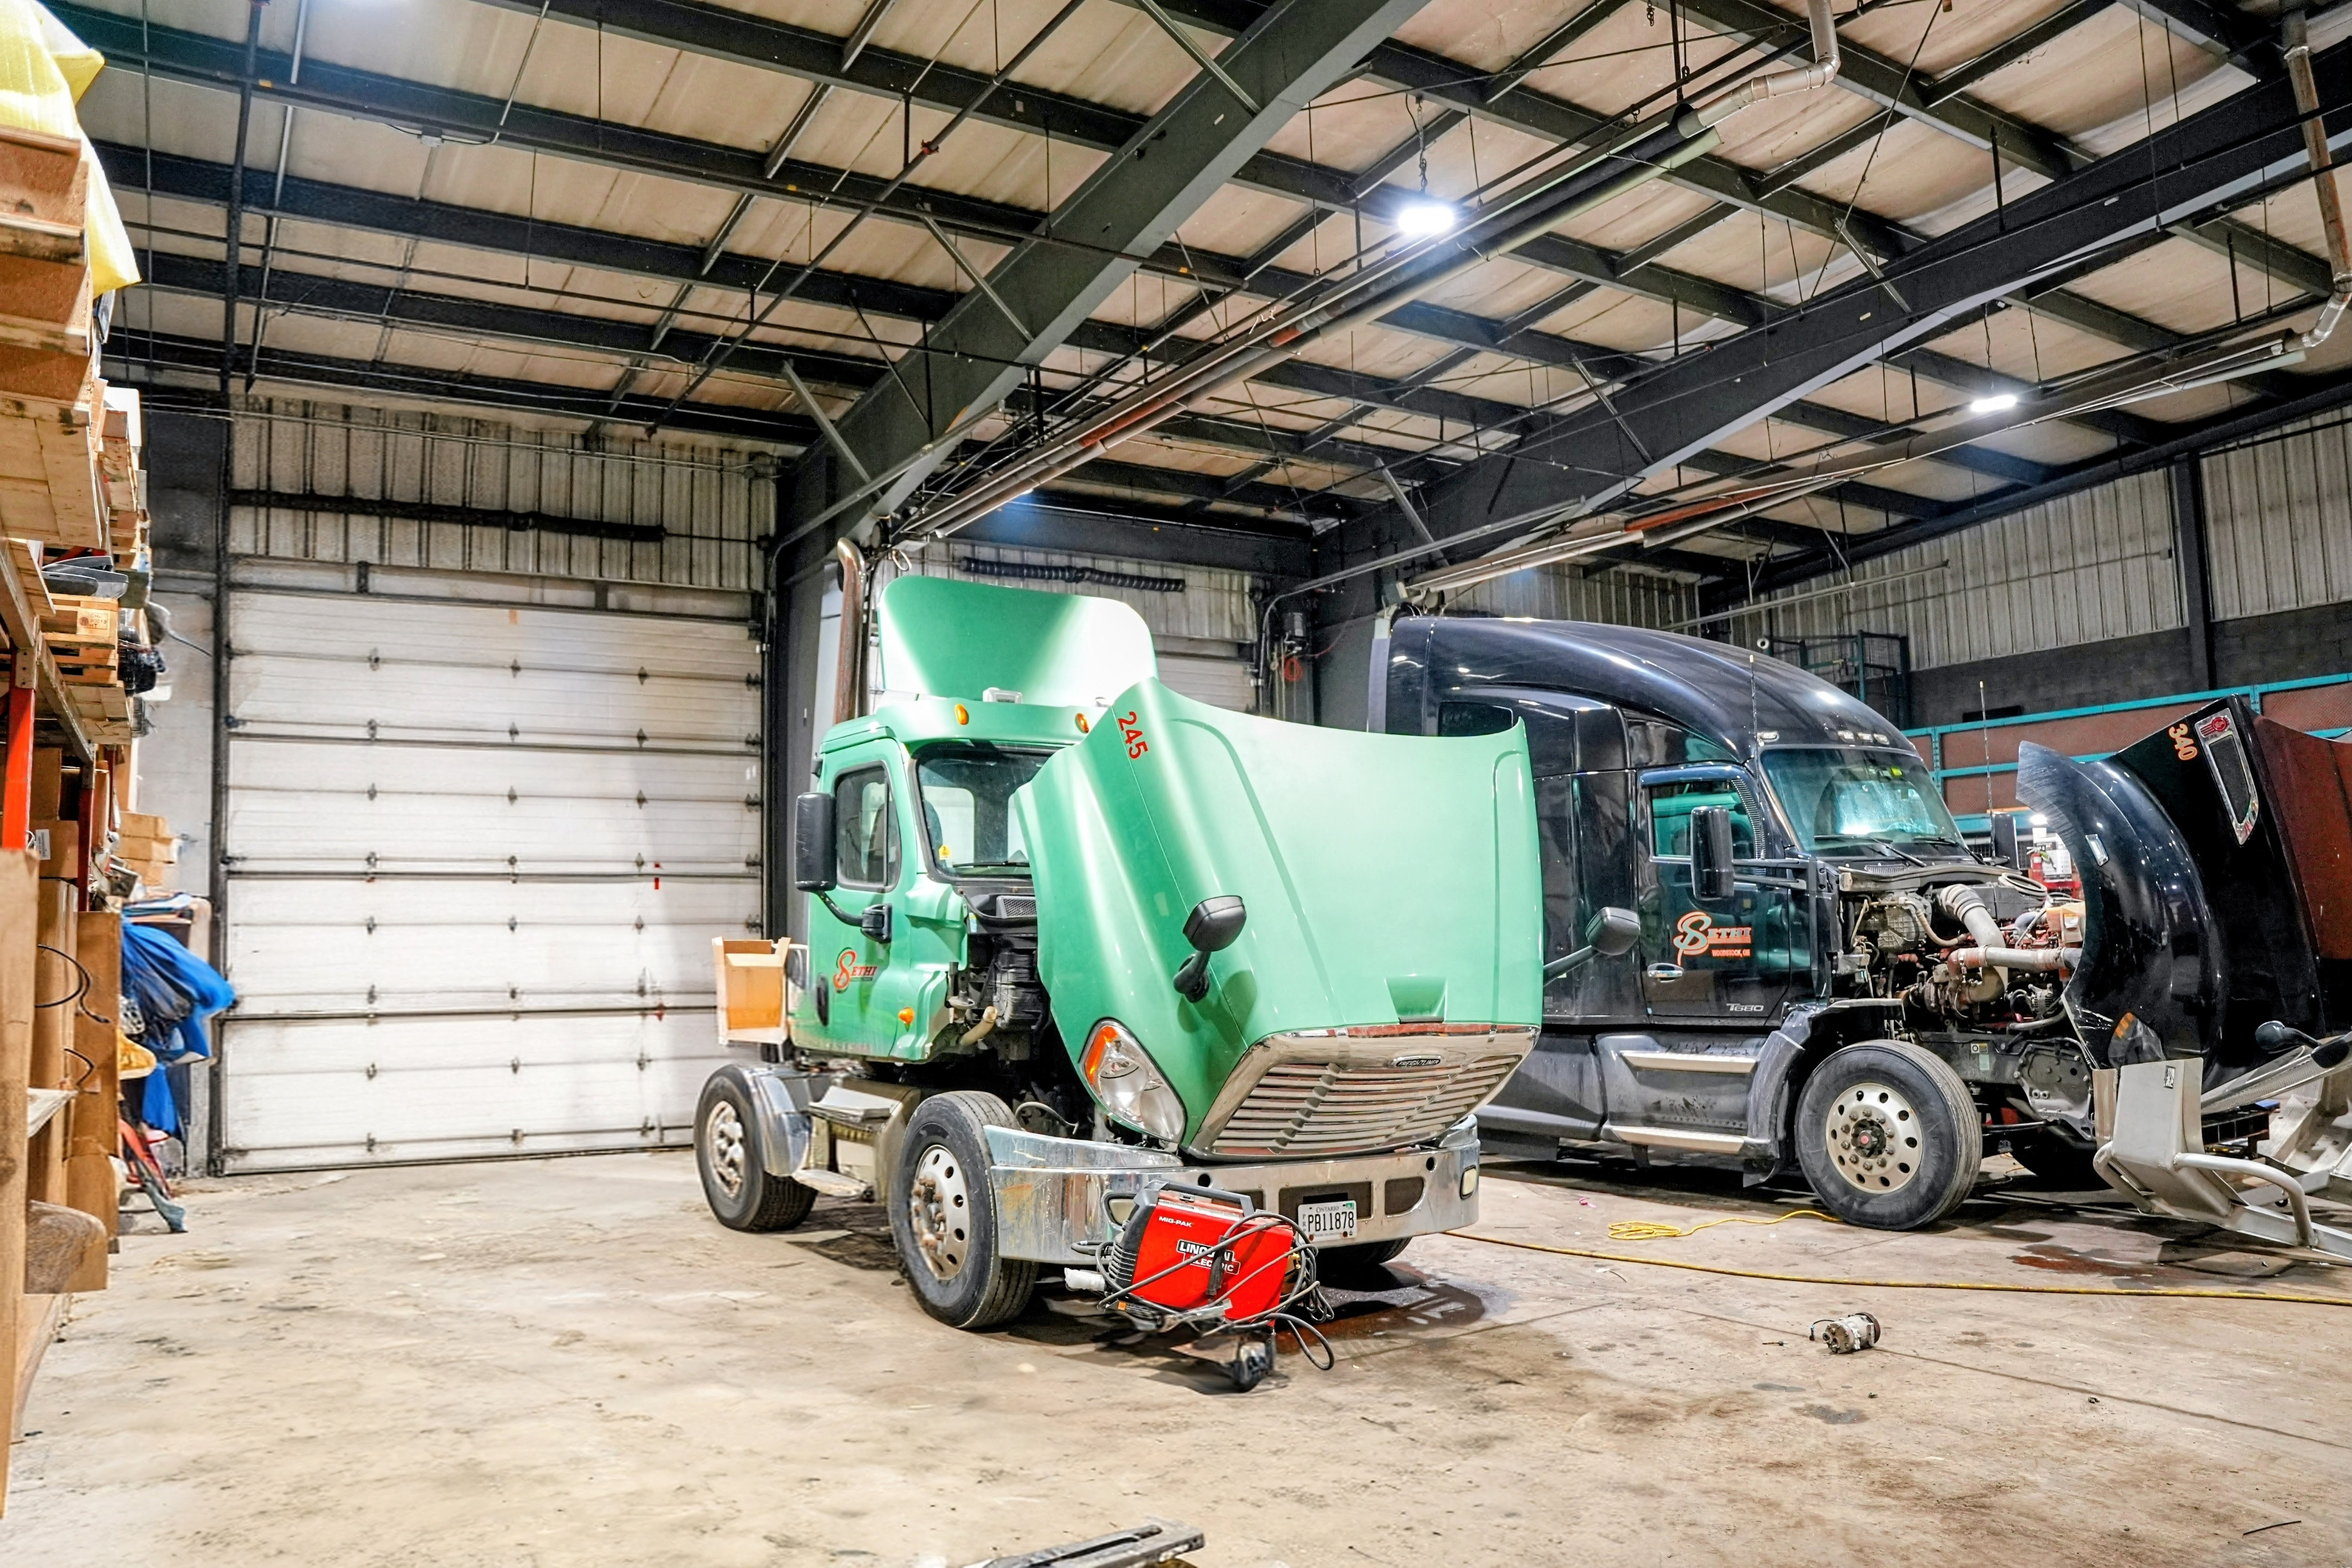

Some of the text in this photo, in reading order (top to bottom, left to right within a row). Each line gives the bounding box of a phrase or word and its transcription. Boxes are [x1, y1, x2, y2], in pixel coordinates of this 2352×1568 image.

[1118, 711, 1148, 759] 245
[2168, 723, 2198, 761] 340
[1712, 949, 1742, 957] WOODSTOCK,
[1726, 1003, 1764, 1011] T680
[1159, 1216, 1192, 1228] MIG-PAK
[1308, 1211, 1354, 1232] PB11878
[1179, 1242, 1231, 1261] LINCN
[1190, 1256, 1234, 1272] LECIC
